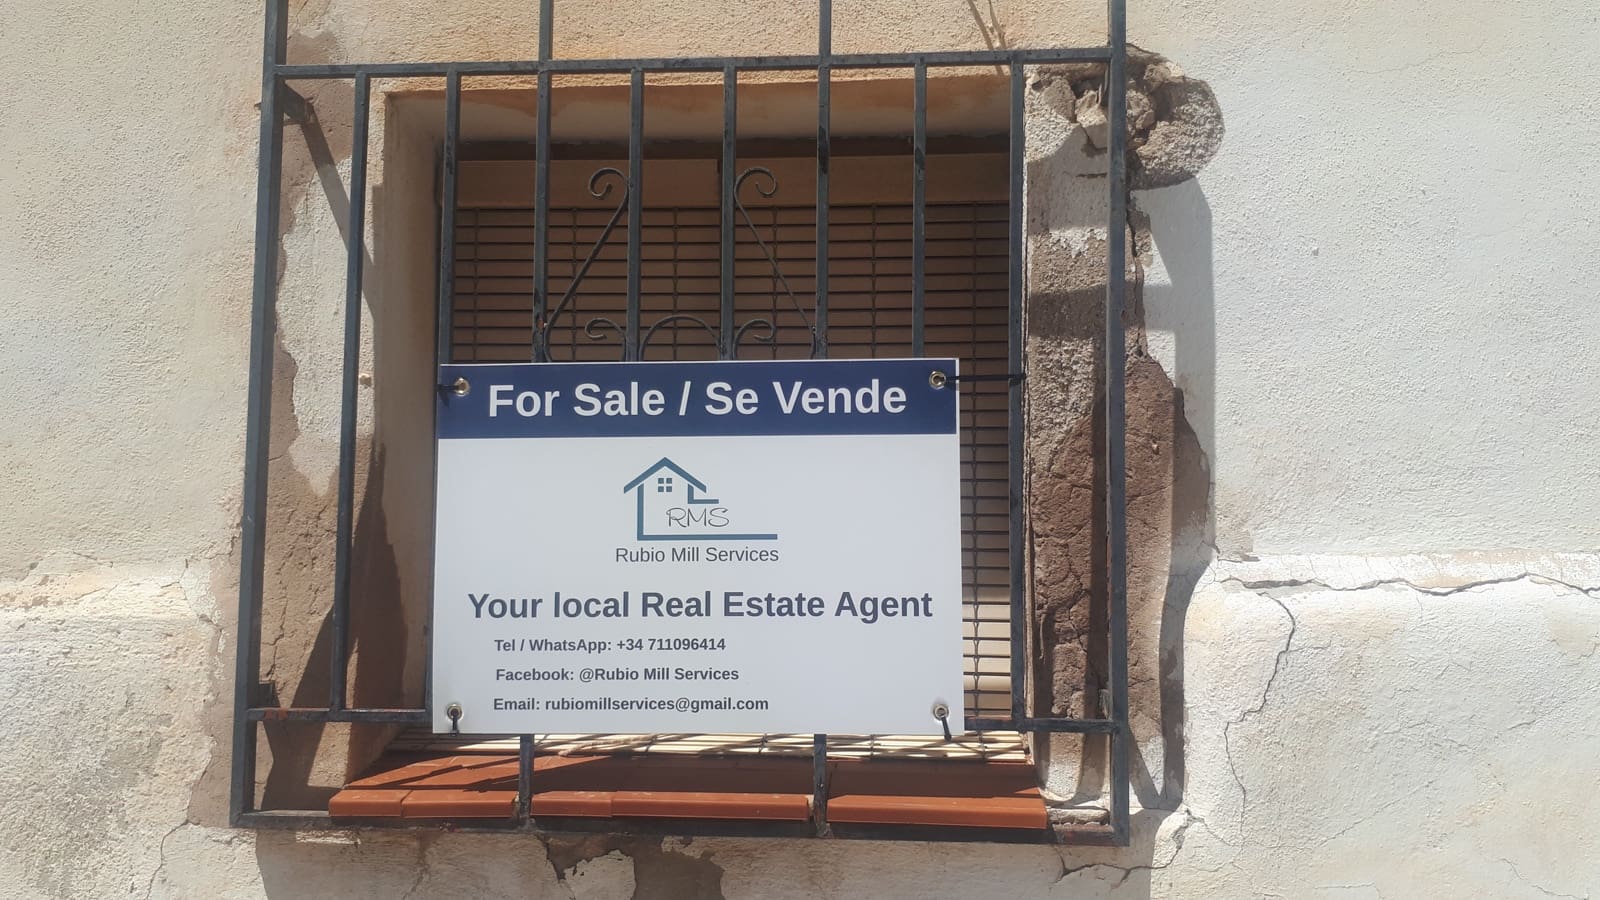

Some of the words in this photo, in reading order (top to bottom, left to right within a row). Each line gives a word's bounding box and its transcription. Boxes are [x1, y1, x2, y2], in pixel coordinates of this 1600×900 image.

[489, 384, 561, 418] For
[573, 381, 666, 417] Sale
[678, 380, 692, 417] /
[704, 381, 759, 416] Se
[773, 378, 907, 415] Vende
[665, 506, 730, 529] RMS
[615, 546, 666, 563] Rubio
[671, 546, 700, 563] Mill
[706, 545, 780, 562] Services
[467, 593, 544, 619] Your
[553, 590, 630, 618] local
[641, 590, 712, 618] Real
[723, 591, 825, 618] Estate
[834, 591, 934, 626] Agent
[494, 638, 516, 652] Tel
[519, 638, 526, 652] /
[528, 638, 612, 655] WhatsApp:
[616, 638, 644, 651] +34
[647, 637, 727, 651] 711096414
[495, 667, 574, 681] Facebook:
[579, 667, 640, 683] @Rubio
[643, 667, 670, 681] Mill
[674, 666, 740, 681] Services
[493, 697, 540, 711] Email:
[545, 696, 769, 715] rubiomillservices@gmail.com
